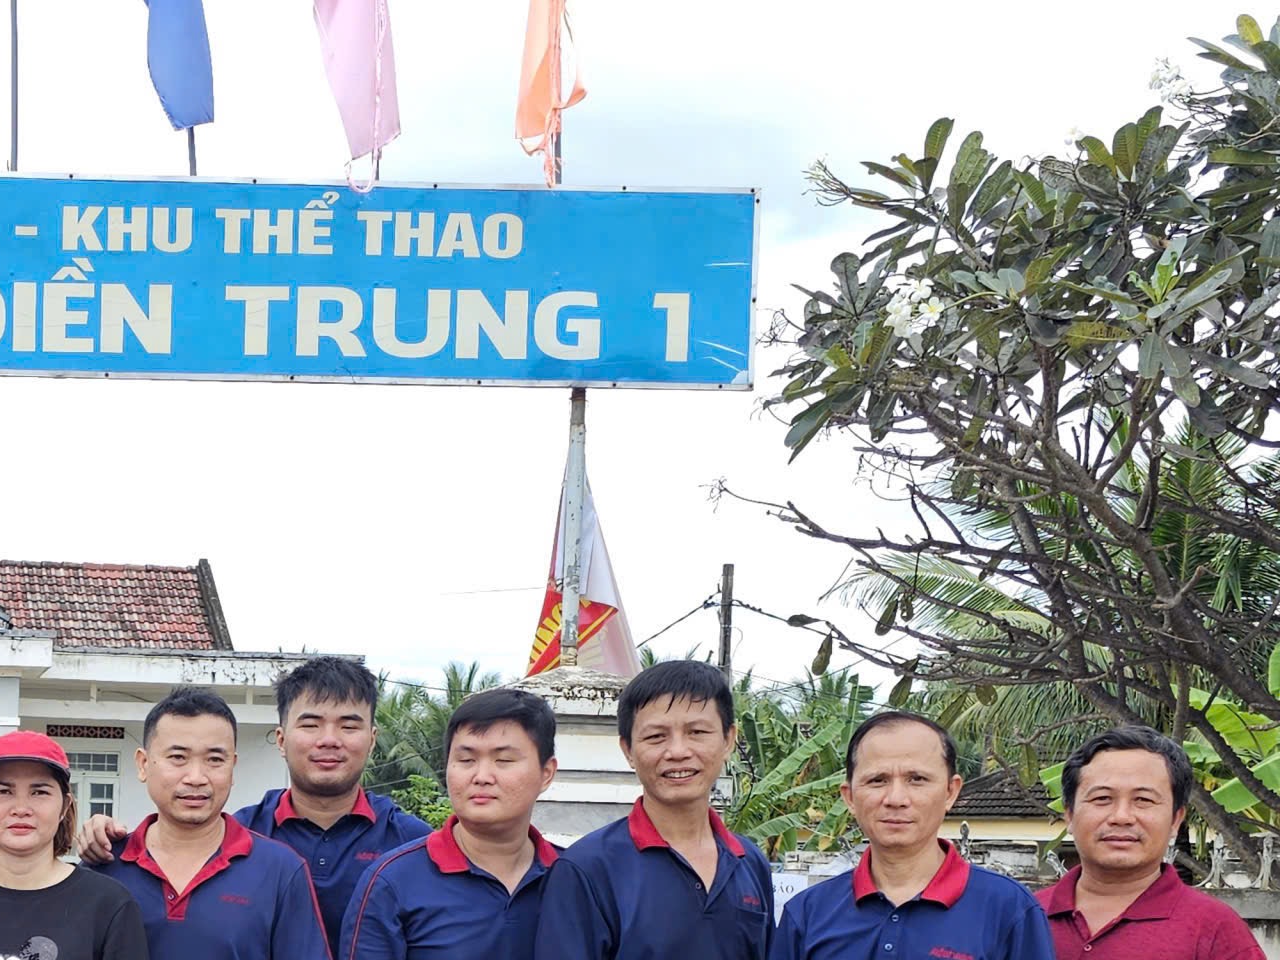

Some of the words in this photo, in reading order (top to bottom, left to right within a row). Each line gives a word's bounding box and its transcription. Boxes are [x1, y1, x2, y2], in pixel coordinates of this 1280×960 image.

[14, 225, 38, 236] -
[62, 205, 193, 253] KHU
[215, 191, 341, 255] THỂ
[356, 210, 524, 259] THAO
[224, 285, 601, 361] TRUNG
[653, 292, 691, 362] 1
